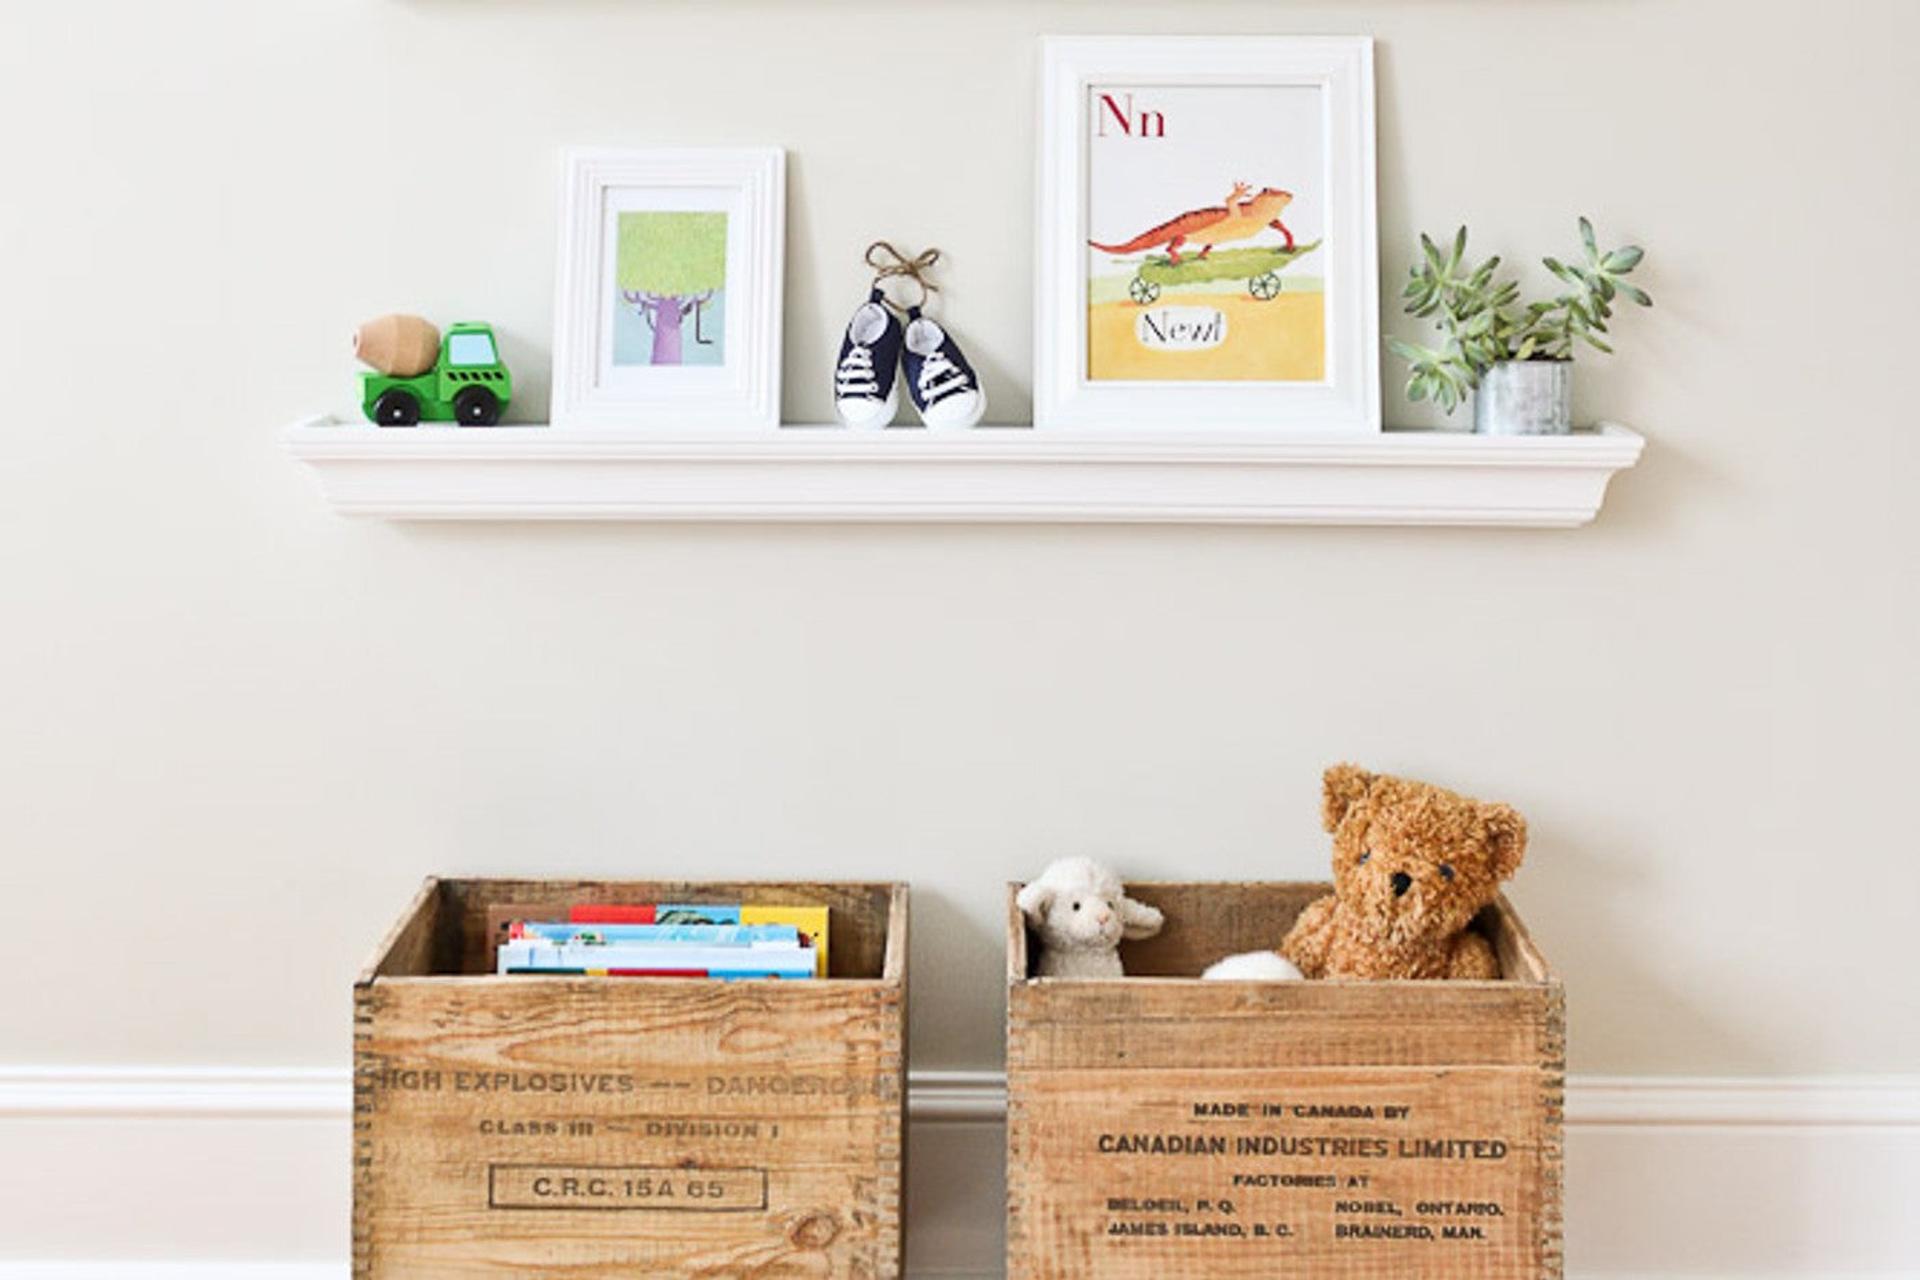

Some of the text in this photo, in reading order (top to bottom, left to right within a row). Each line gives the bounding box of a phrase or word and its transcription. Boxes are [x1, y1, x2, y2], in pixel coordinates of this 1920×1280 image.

[1097, 93, 1166, 137] Nn
[455, 1071, 634, 1093] EXPLOSIVES
[1193, 1102, 1410, 1119] MADE IN CANADA BY
[479, 1119, 558, 1135] CLASS
[645, 1121, 757, 1138] DIVISION
[1098, 1134, 1507, 1159] CANADIAN INDUSTRIES LIMITED
[532, 1177, 613, 1197] C.R.C.
[686, 1179, 724, 1198] 65
[1233, 1174, 1370, 1188] FACTORIES AT
[1108, 1222, 1168, 1236] JAMES
[1174, 1223, 1247, 1239] ISLAND,
[1335, 1225, 1435, 1241] BRAINERD,
